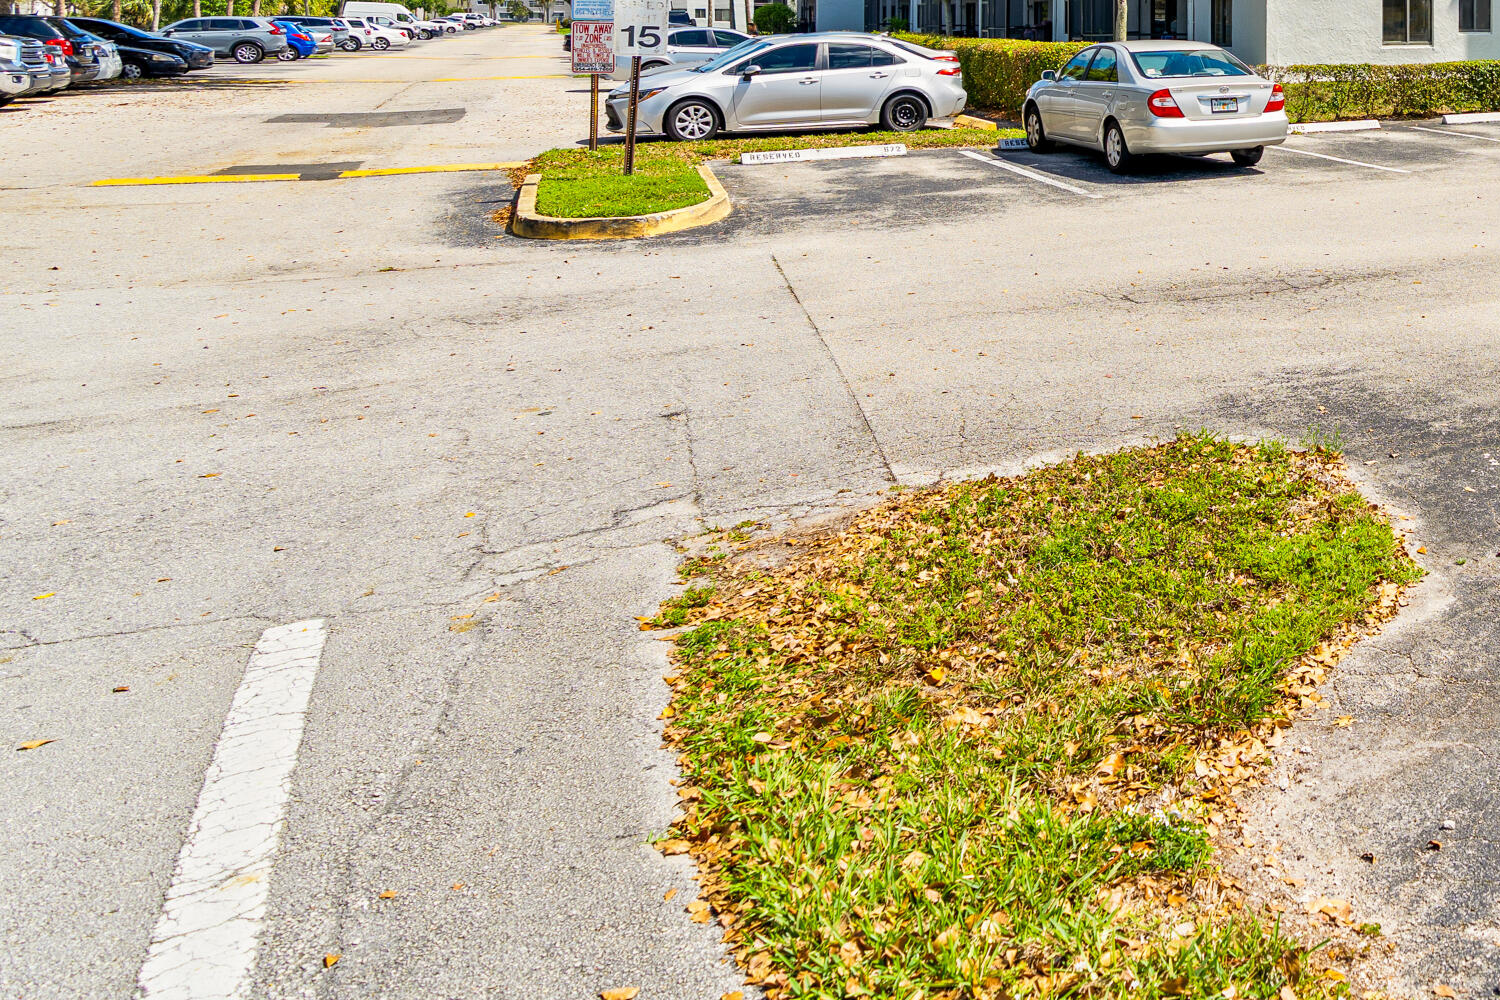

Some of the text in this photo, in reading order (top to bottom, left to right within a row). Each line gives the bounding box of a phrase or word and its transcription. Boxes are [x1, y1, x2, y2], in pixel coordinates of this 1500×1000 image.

[575, 24, 613, 34] TOW AWAY
[584, 33, 603, 43] ZONE
[620, 25, 661, 48] 15
[749, 151, 801, 161] RESERVED
